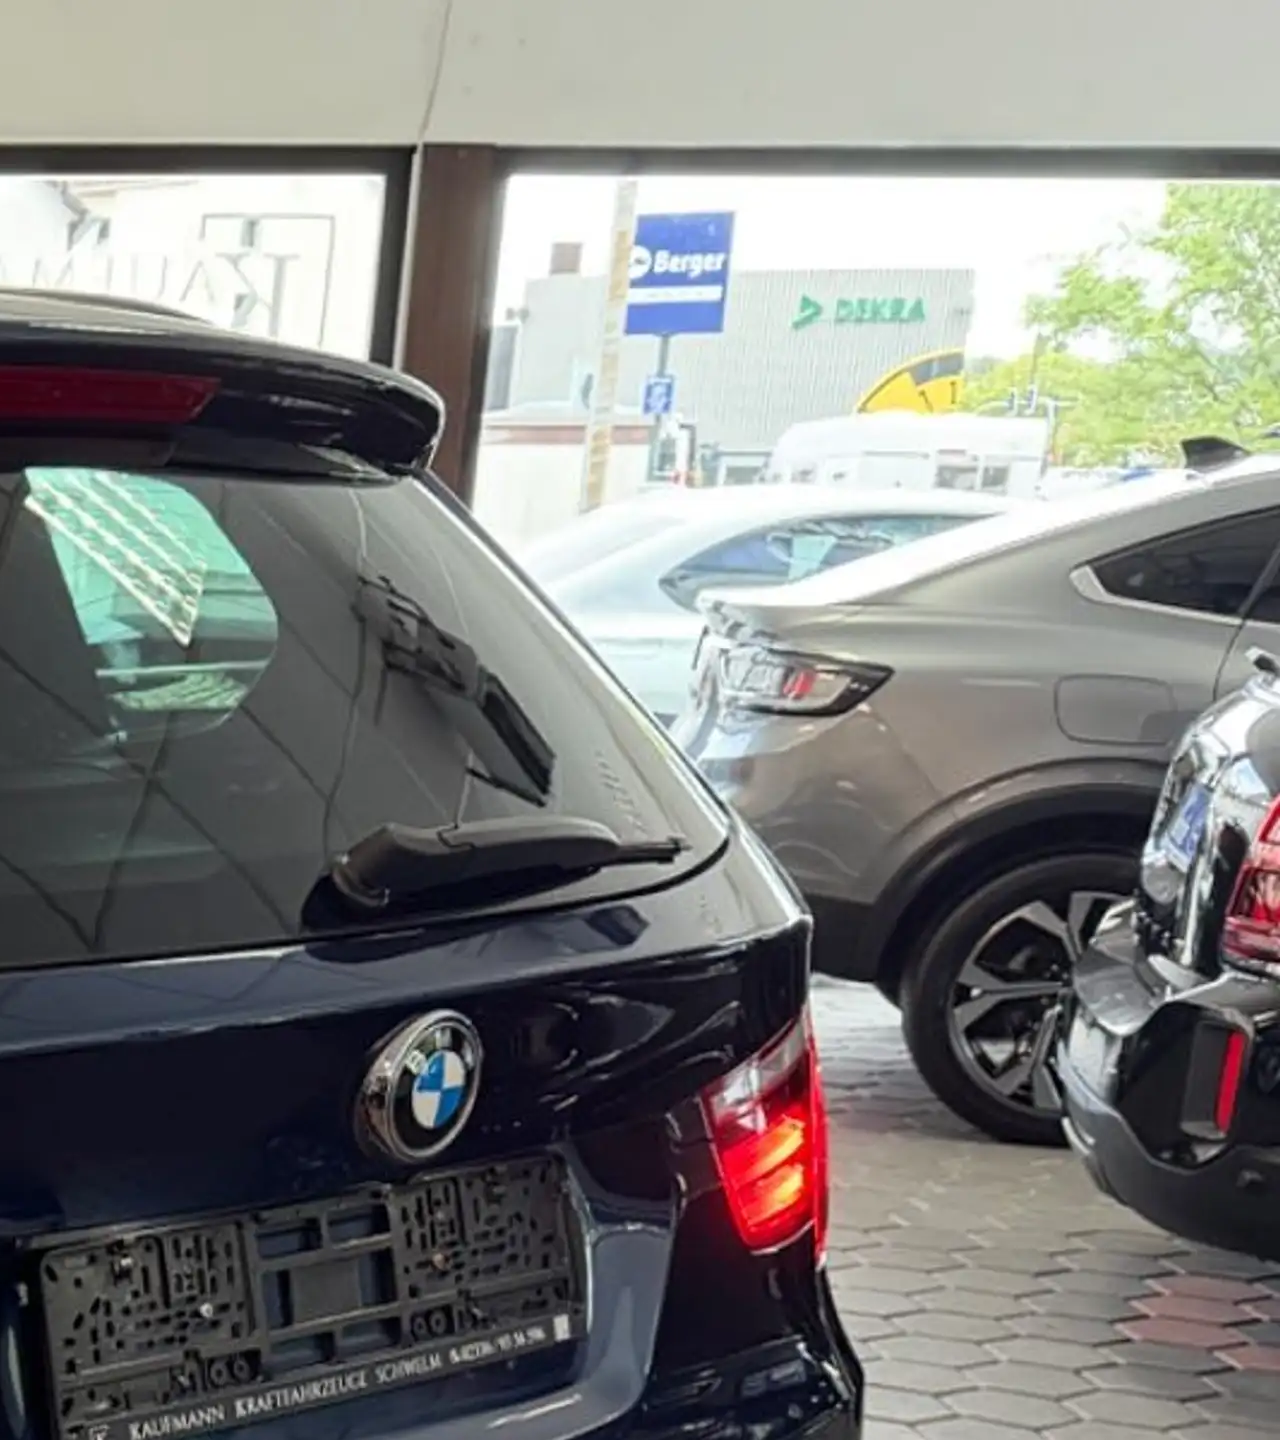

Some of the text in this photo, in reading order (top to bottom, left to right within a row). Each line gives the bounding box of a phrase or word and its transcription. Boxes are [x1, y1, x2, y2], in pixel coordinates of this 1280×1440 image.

[652, 250, 727, 280] Berger
[834, 295, 926, 324] DEKRA
[234, 1370, 368, 1418] KRAFTFAHRZEUGE
[374, 1352, 443, 1384] SCHWELM
